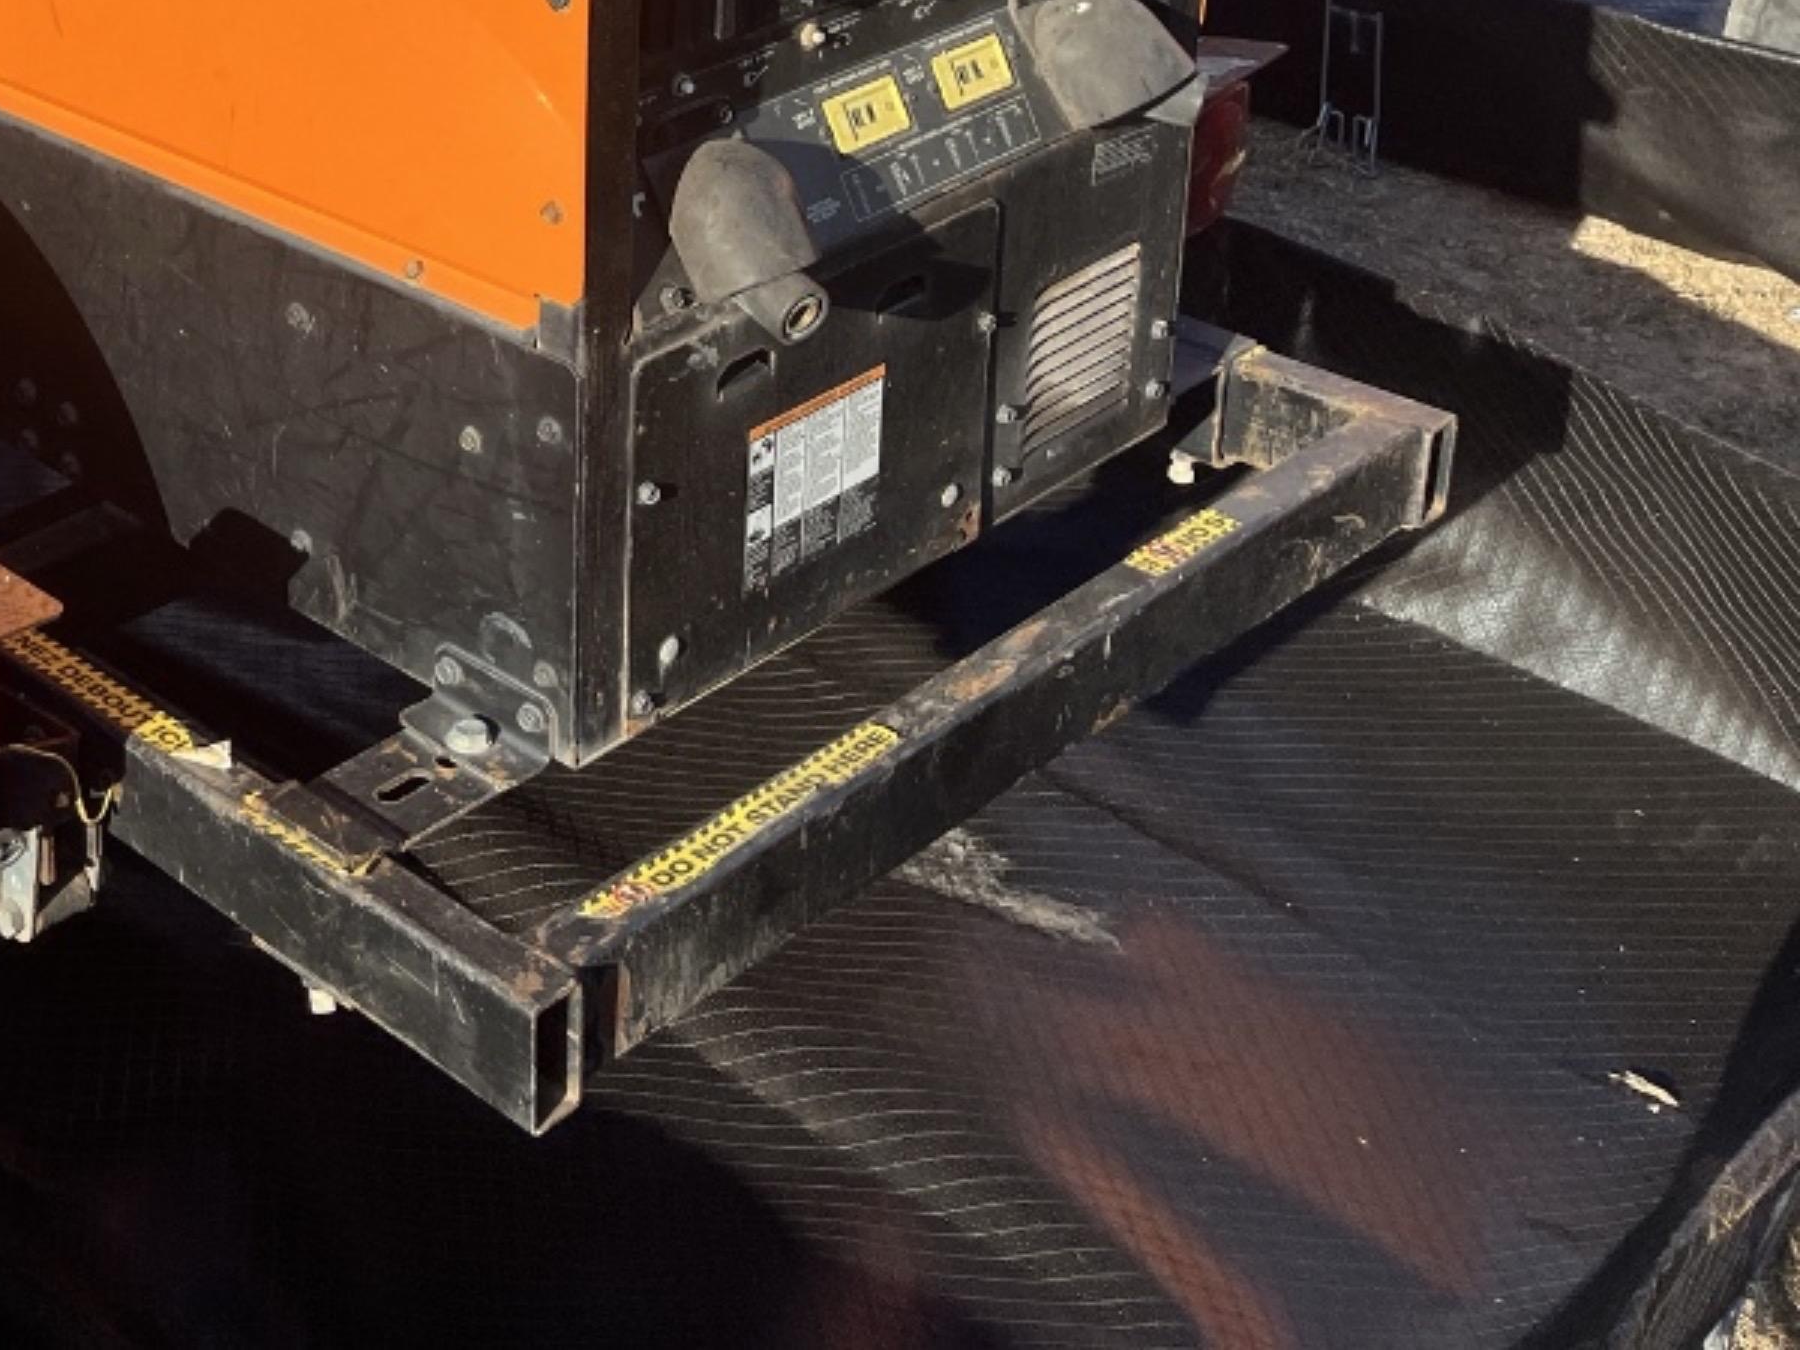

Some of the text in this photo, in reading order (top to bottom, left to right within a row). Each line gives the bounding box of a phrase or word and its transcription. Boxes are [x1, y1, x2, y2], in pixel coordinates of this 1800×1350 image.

[651, 859, 694, 886] DO
[690, 821, 747, 863] NOT
[746, 773, 828, 825] STAND
